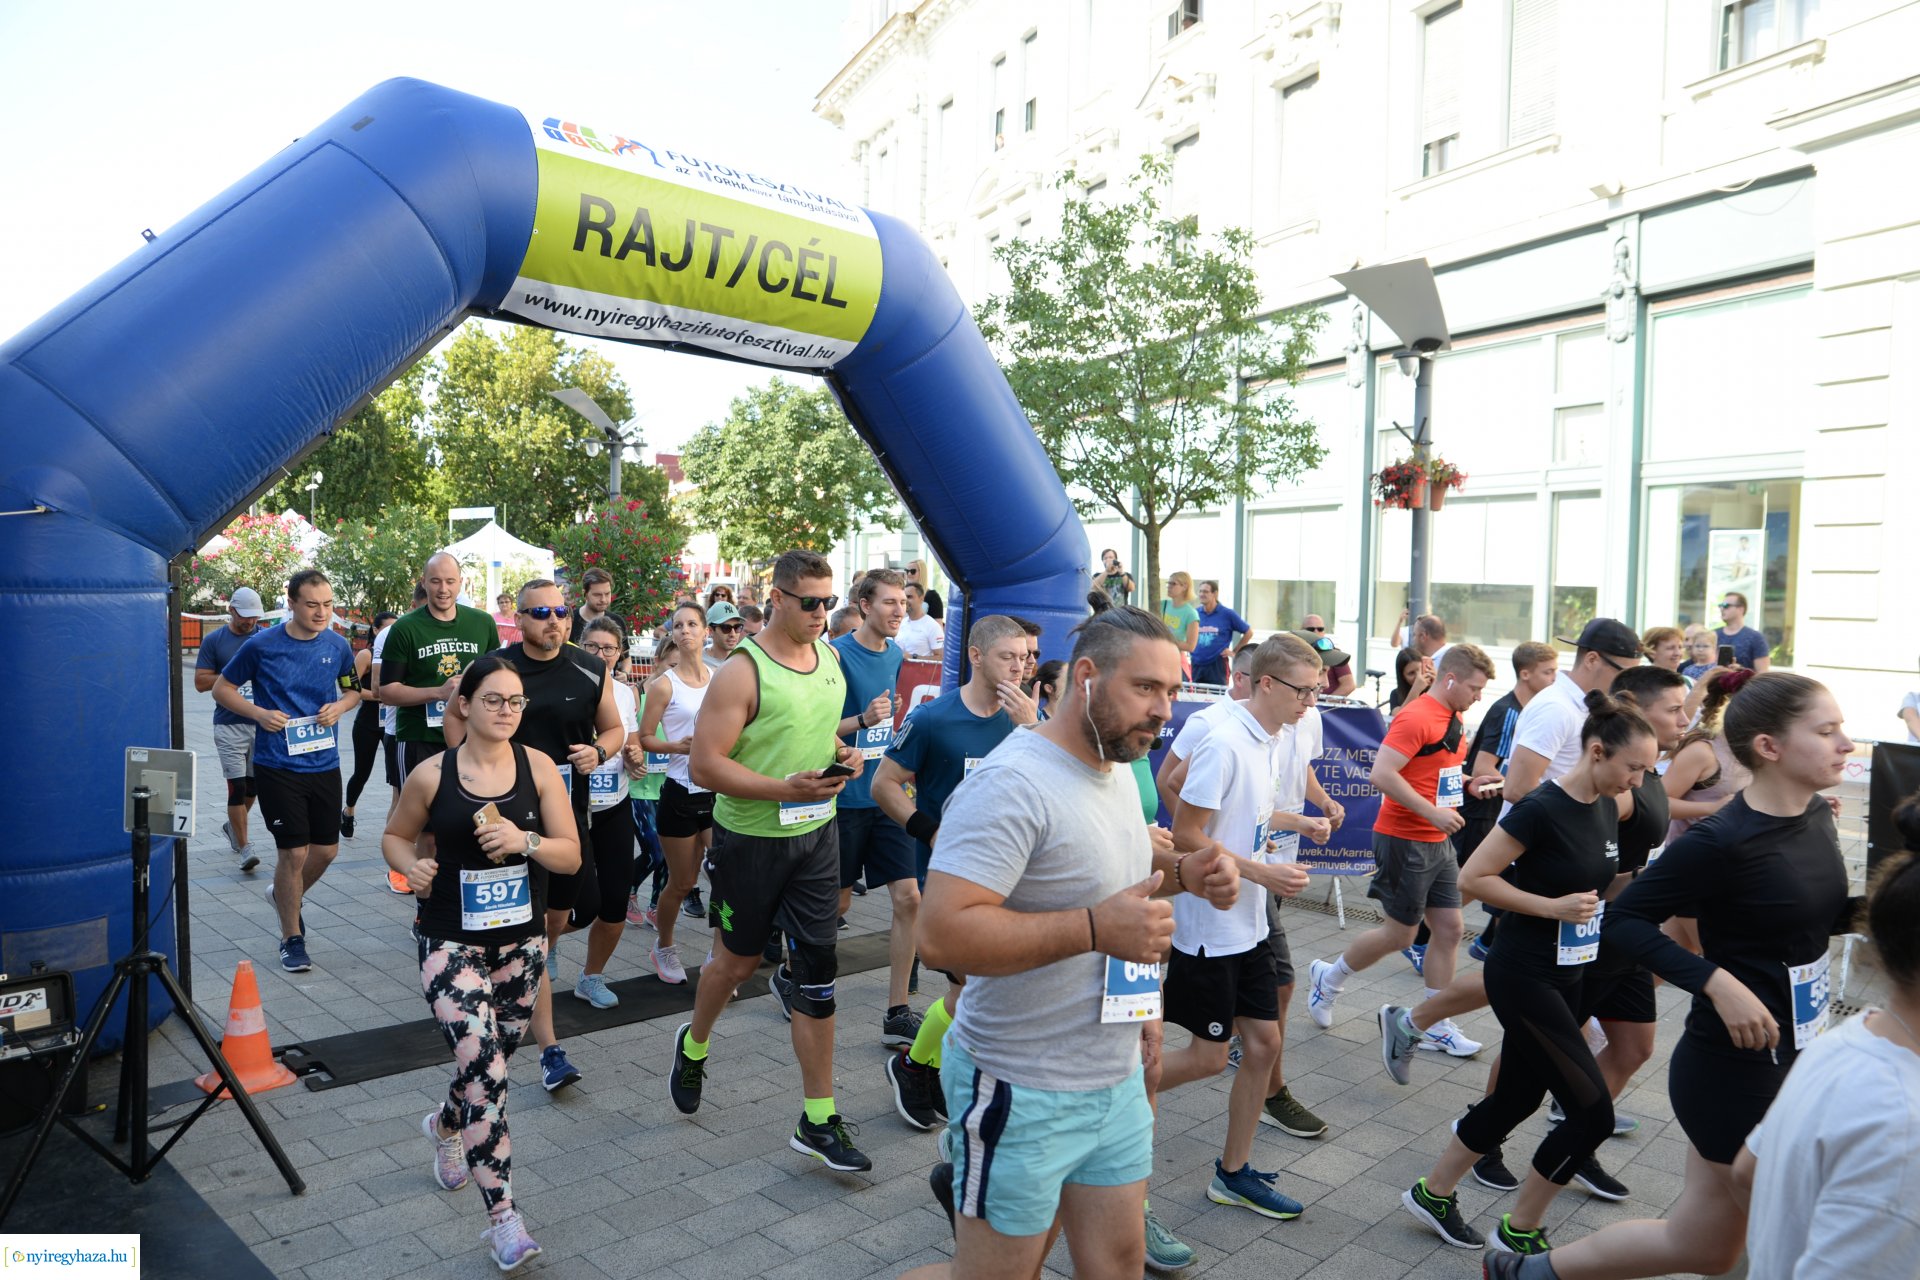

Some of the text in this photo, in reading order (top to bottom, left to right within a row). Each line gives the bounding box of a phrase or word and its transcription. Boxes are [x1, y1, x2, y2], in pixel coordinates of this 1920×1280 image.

[675, 164, 691, 176] az
[572, 193, 848, 309] RAJT/CÉL
[524, 292, 836, 361] www.nyiregyhazifutofesztival.hu
[417, 641, 479, 660] DEBRECEN
[296, 724, 325, 739] 618
[866, 727, 890, 743] 657
[1322, 765, 1341, 778] TE
[178, 816, 188, 831] 7
[475, 879, 524, 905] 597
